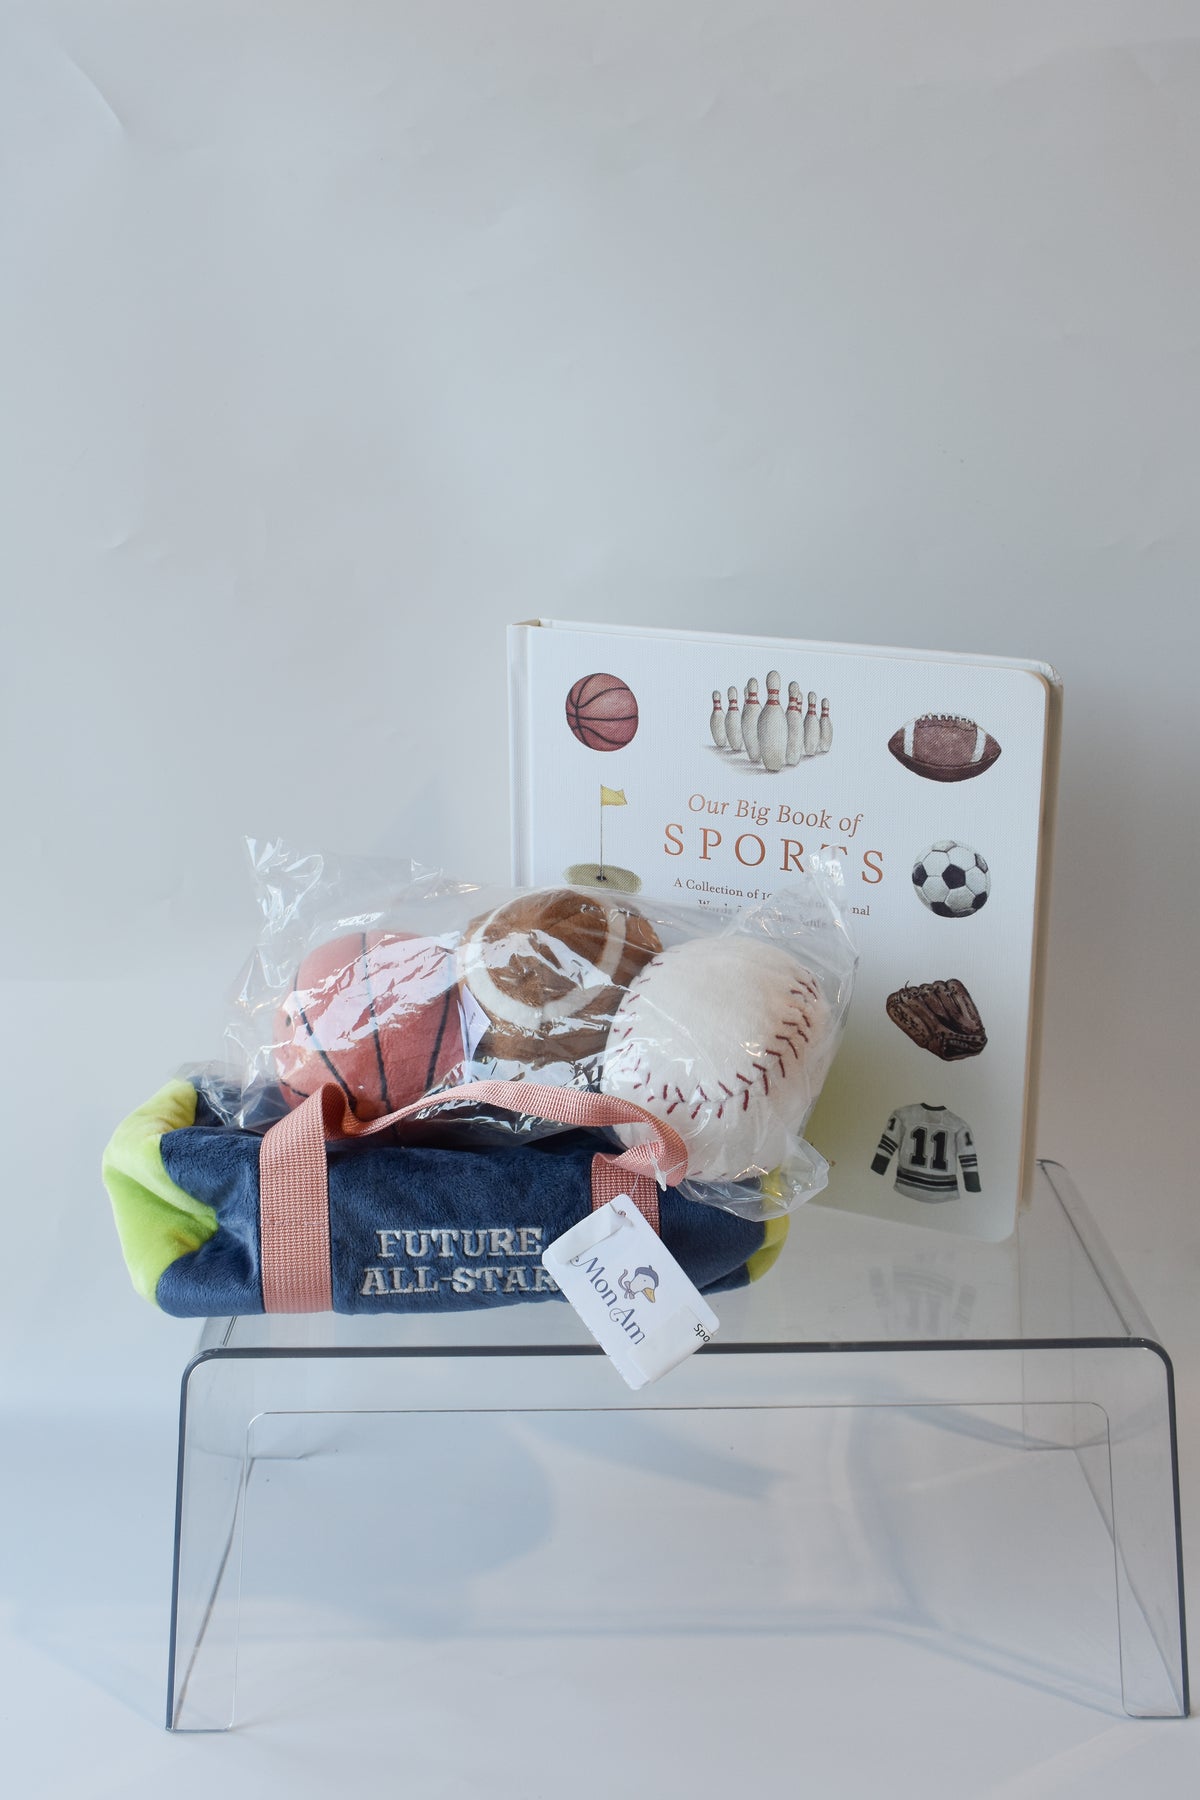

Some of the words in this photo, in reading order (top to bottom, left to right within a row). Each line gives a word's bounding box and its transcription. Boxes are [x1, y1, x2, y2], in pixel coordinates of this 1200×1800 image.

[688, 793, 729, 815] Our
[735, 799, 770, 826] Big
[776, 804, 832, 829] Book
[839, 813, 864, 838] of
[664, 823, 884, 884] SPORTS
[674, 878, 682, 888] A
[686, 879, 743, 898] Collection
[747, 889, 760, 899] of
[910, 1126, 948, 1172] 11
[375, 1227, 543, 1258] FUTURE
[693, 1323, 711, 1343] Spo
